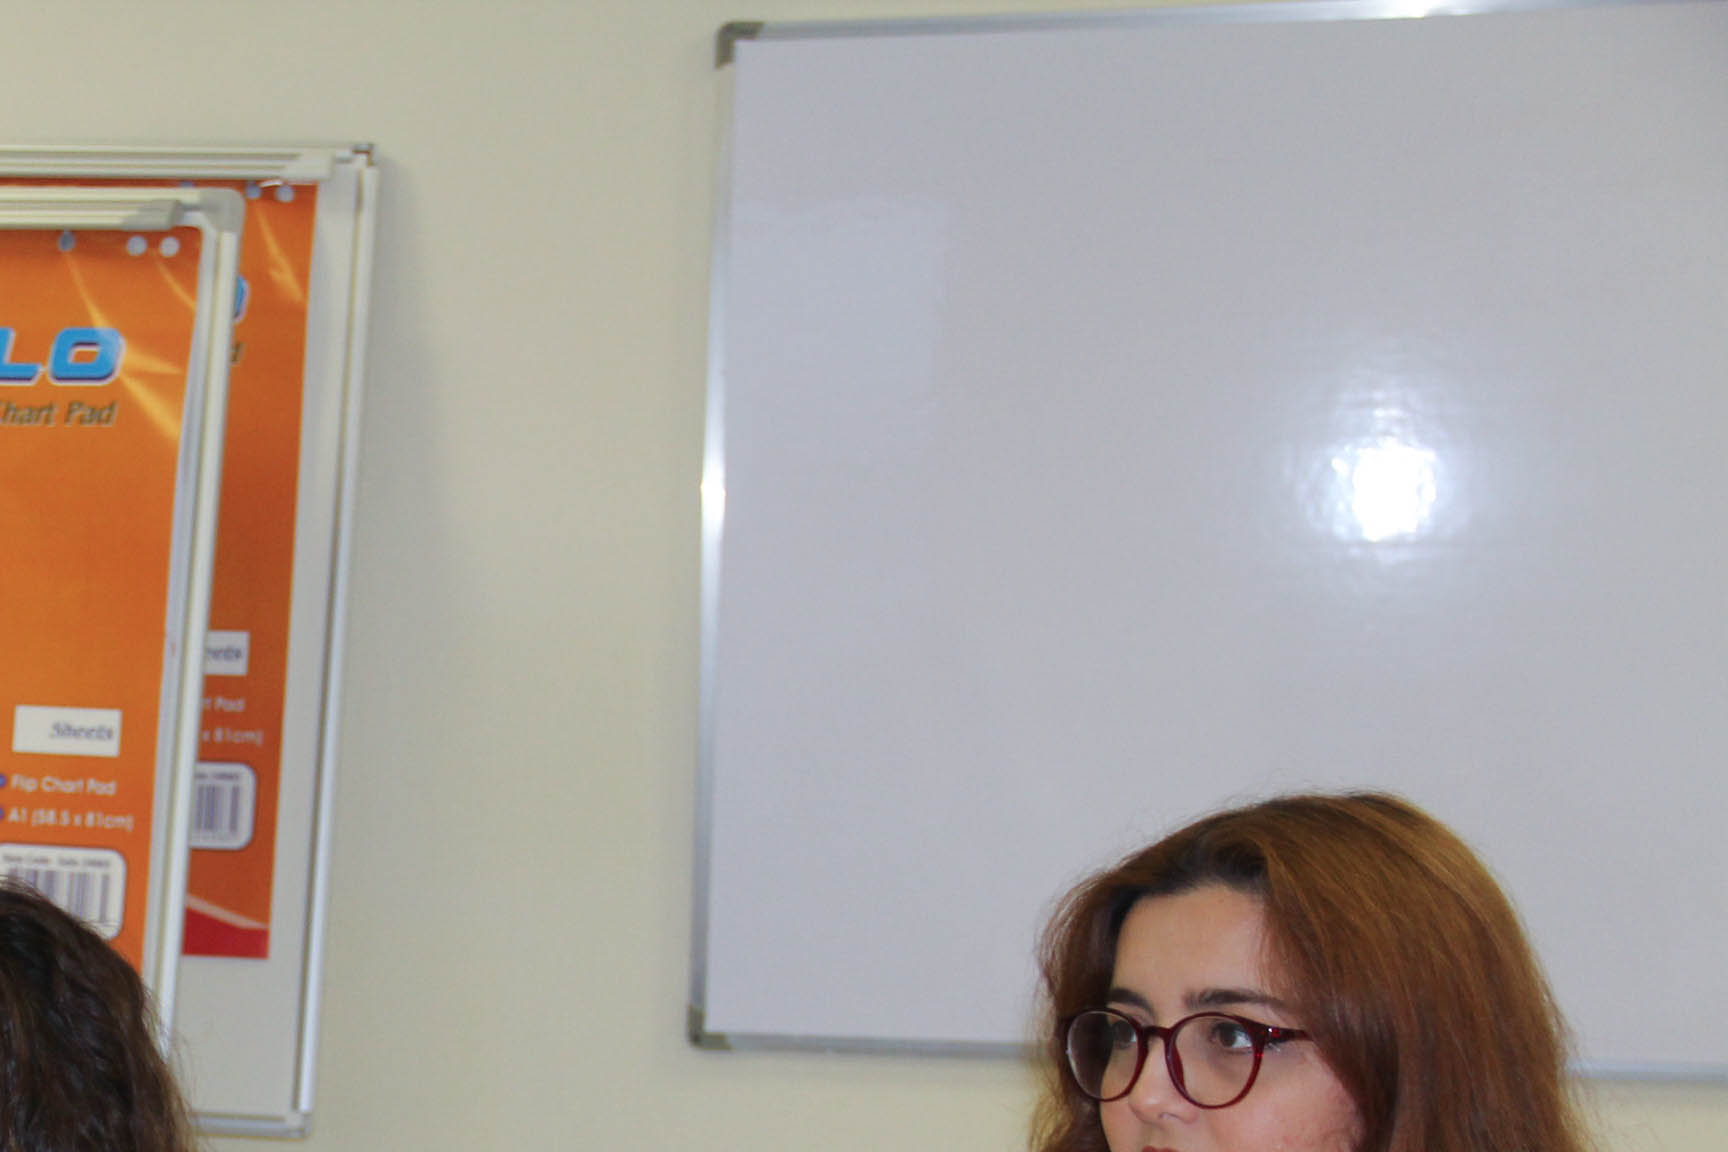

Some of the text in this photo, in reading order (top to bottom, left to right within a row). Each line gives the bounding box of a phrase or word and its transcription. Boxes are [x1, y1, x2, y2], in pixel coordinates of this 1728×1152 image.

[63, 401, 117, 427] Pad
[50, 722, 114, 741] Sheets
[11, 773, 117, 796] Flip Chart Pad
